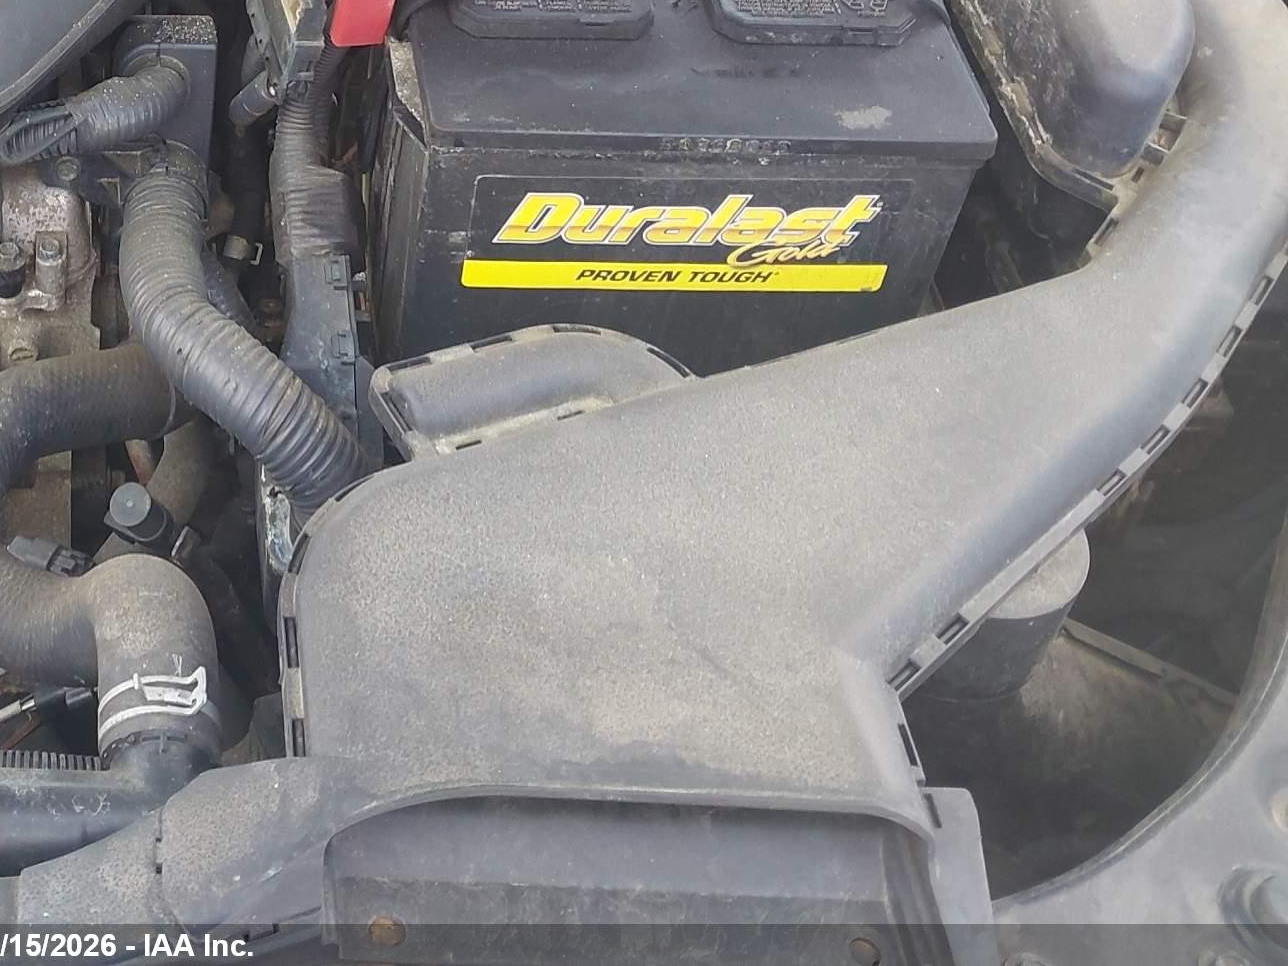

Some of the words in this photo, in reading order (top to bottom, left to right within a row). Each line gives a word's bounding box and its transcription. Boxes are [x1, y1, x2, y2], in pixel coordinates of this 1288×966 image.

[492, 192, 882, 247] Duralast
[726, 236, 848, 268] Gold
[576, 269, 682, 283] PROVEN
[688, 270, 774, 284] TOUGH
